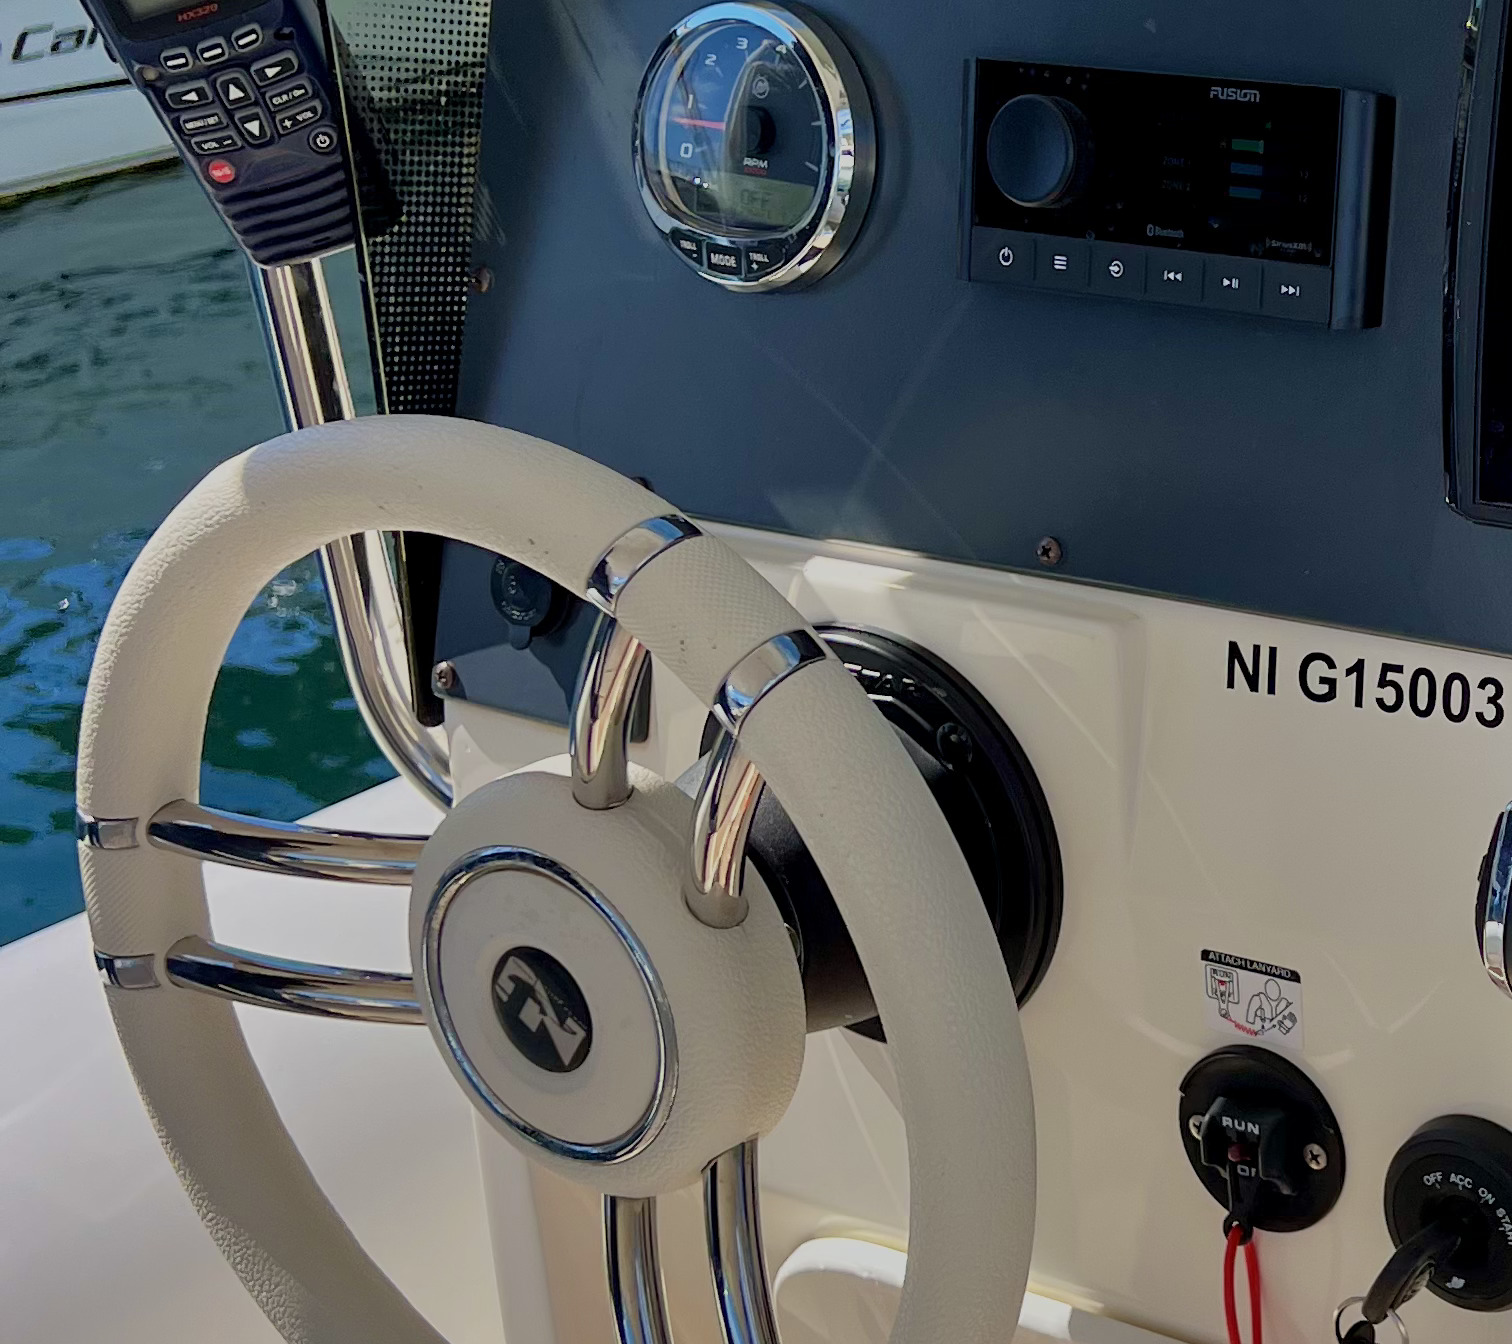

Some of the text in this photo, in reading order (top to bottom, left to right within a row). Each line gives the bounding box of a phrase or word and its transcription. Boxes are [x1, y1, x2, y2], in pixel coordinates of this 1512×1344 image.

[736, 37, 748, 50] 3
[775, 44, 788, 54] 4
[705, 53, 717, 66] 2
[687, 94, 694, 109] 1
[1210, 86, 1261, 103] FUSION
[680, 142, 693, 158] 0
[743, 157, 768, 169] RPM
[710, 252, 737, 268] MODE
[1227, 640, 1504, 728] NI G15003
[1208, 951, 1246, 968] ATTACH
[1246, 959, 1291, 978] LANYARD
[1221, 1116, 1259, 1135] RUN
[1423, 1171, 1442, 1186] OFF
[1449, 1173, 1472, 1188] ACC
[1478, 1187, 1495, 1205] ON
